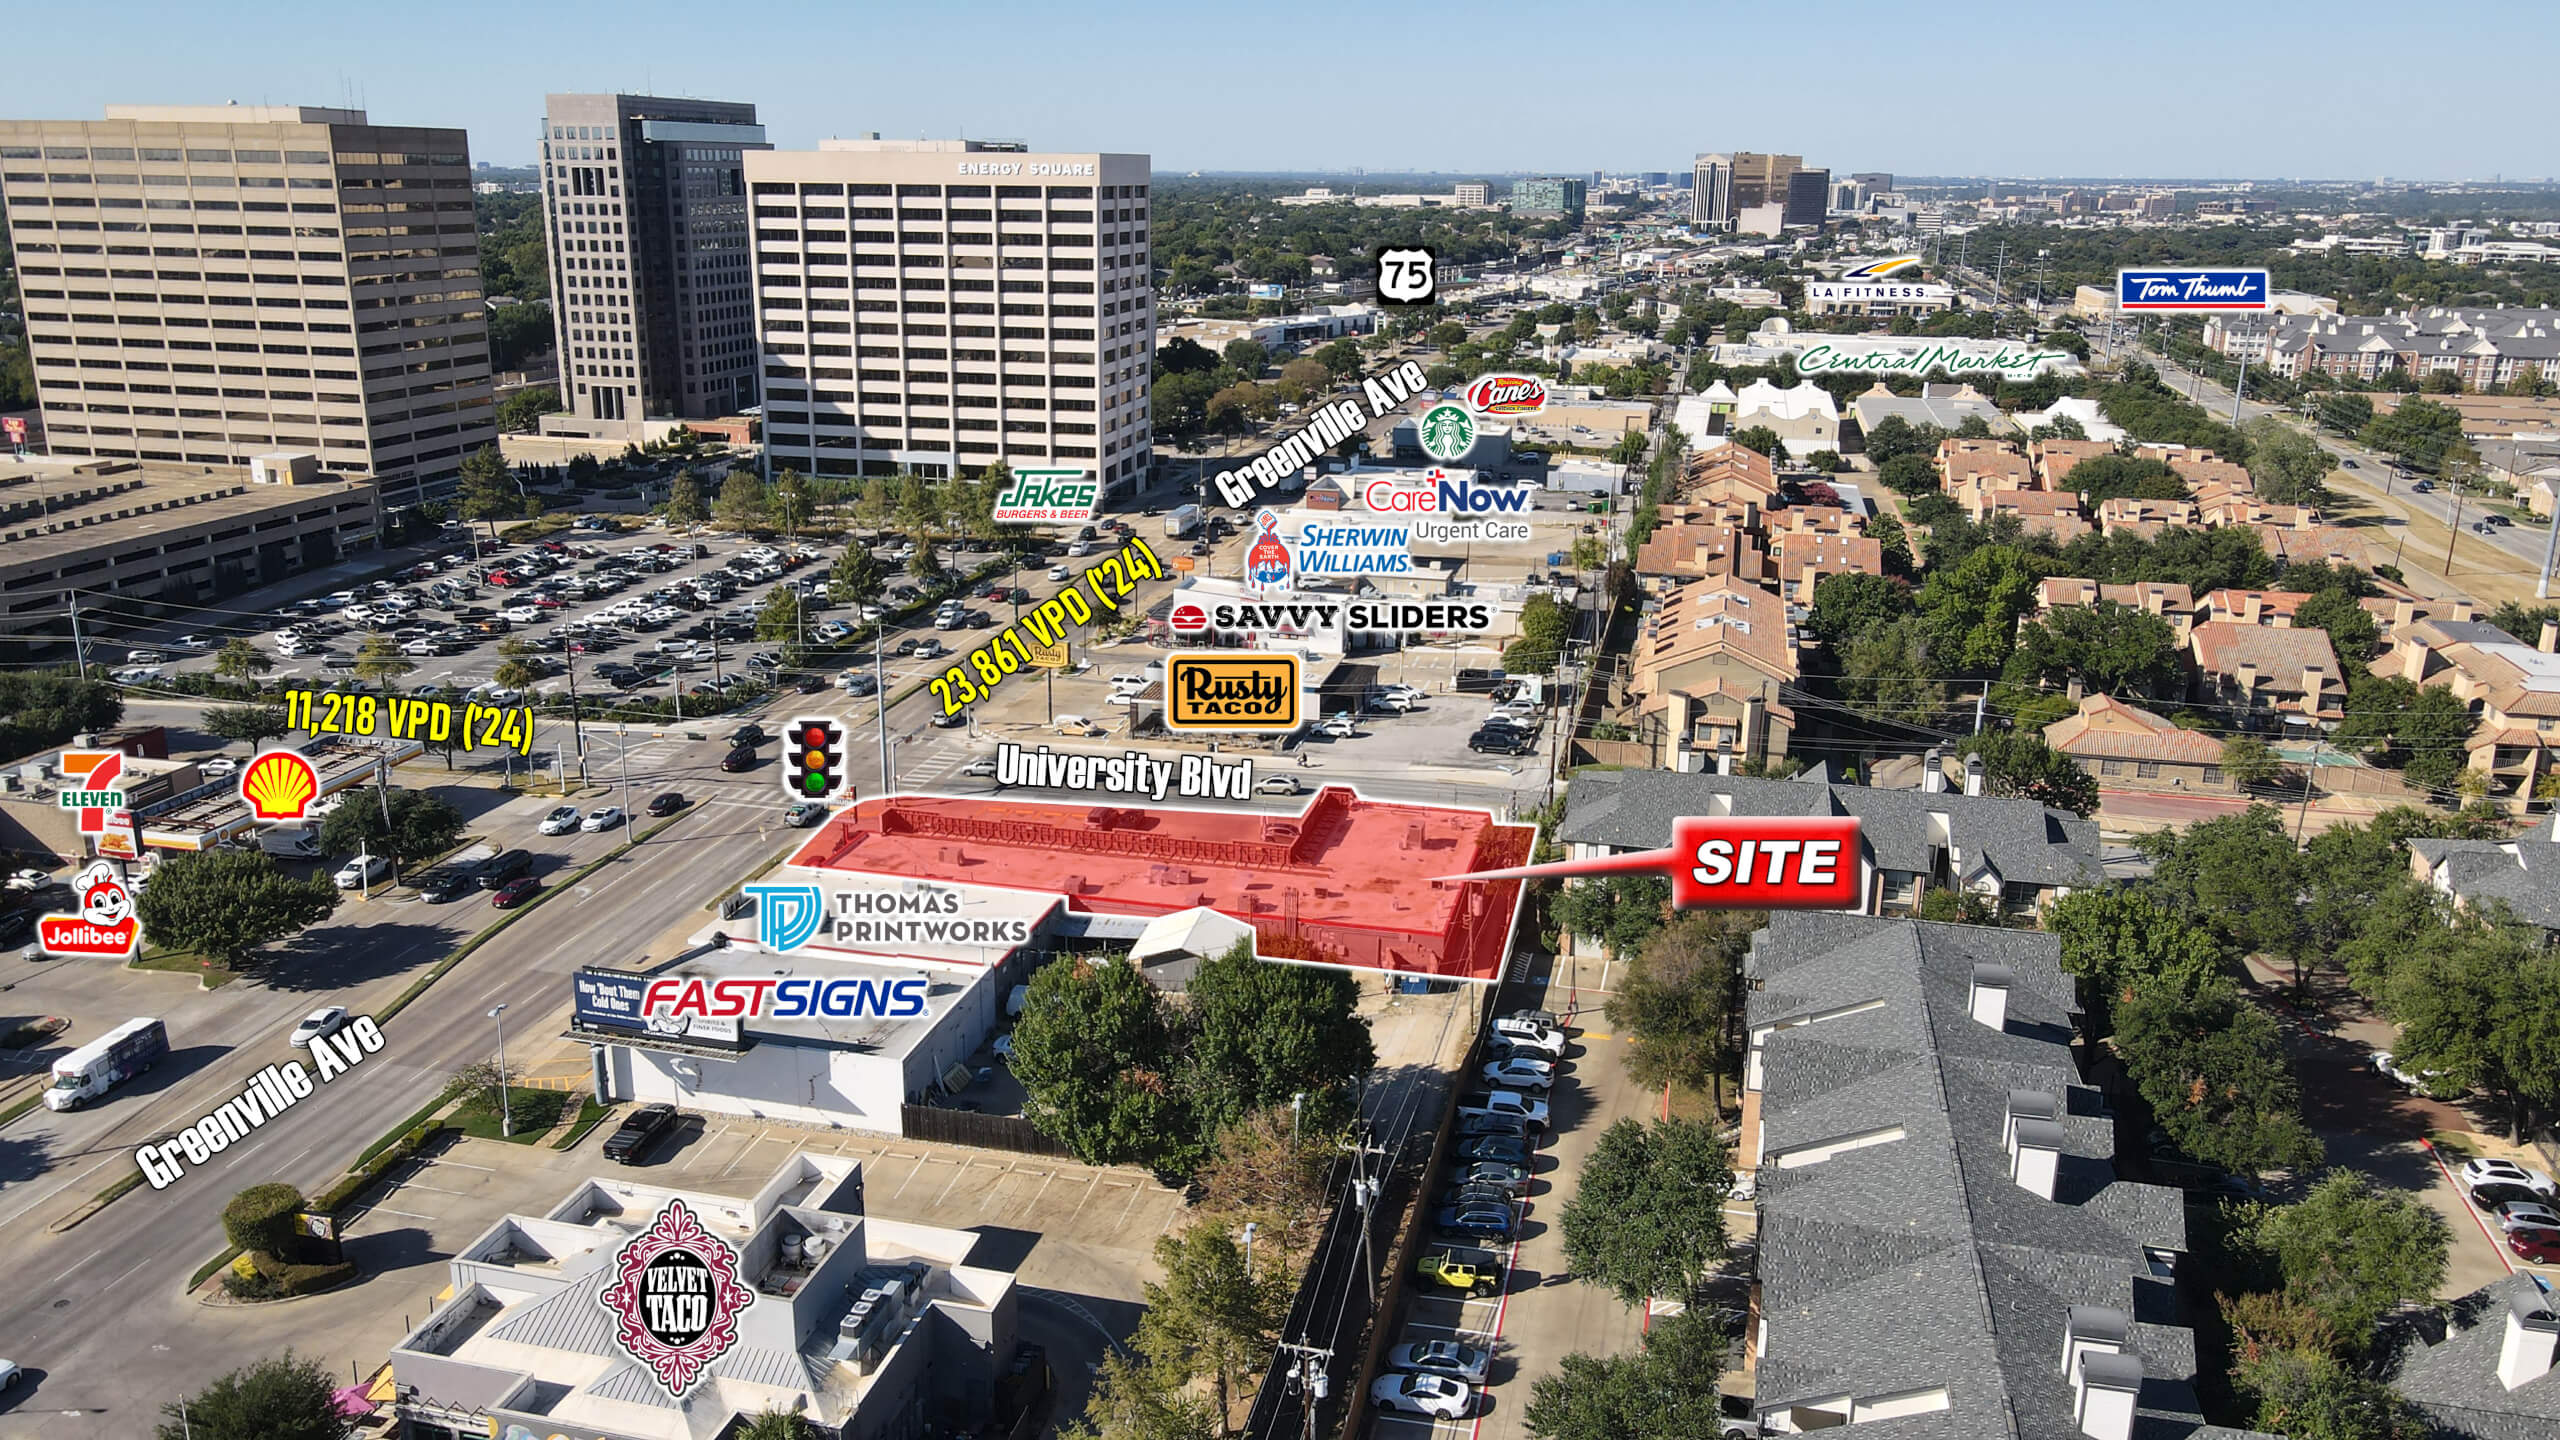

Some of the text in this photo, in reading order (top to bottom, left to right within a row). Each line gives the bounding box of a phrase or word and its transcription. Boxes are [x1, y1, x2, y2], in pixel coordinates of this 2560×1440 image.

[959, 162, 1095, 177] ENERGY SQUARE
[579, 979, 596, 994] How
[618, 984, 640, 1000] Them
[592, 994, 630, 1012] Cold Ones
